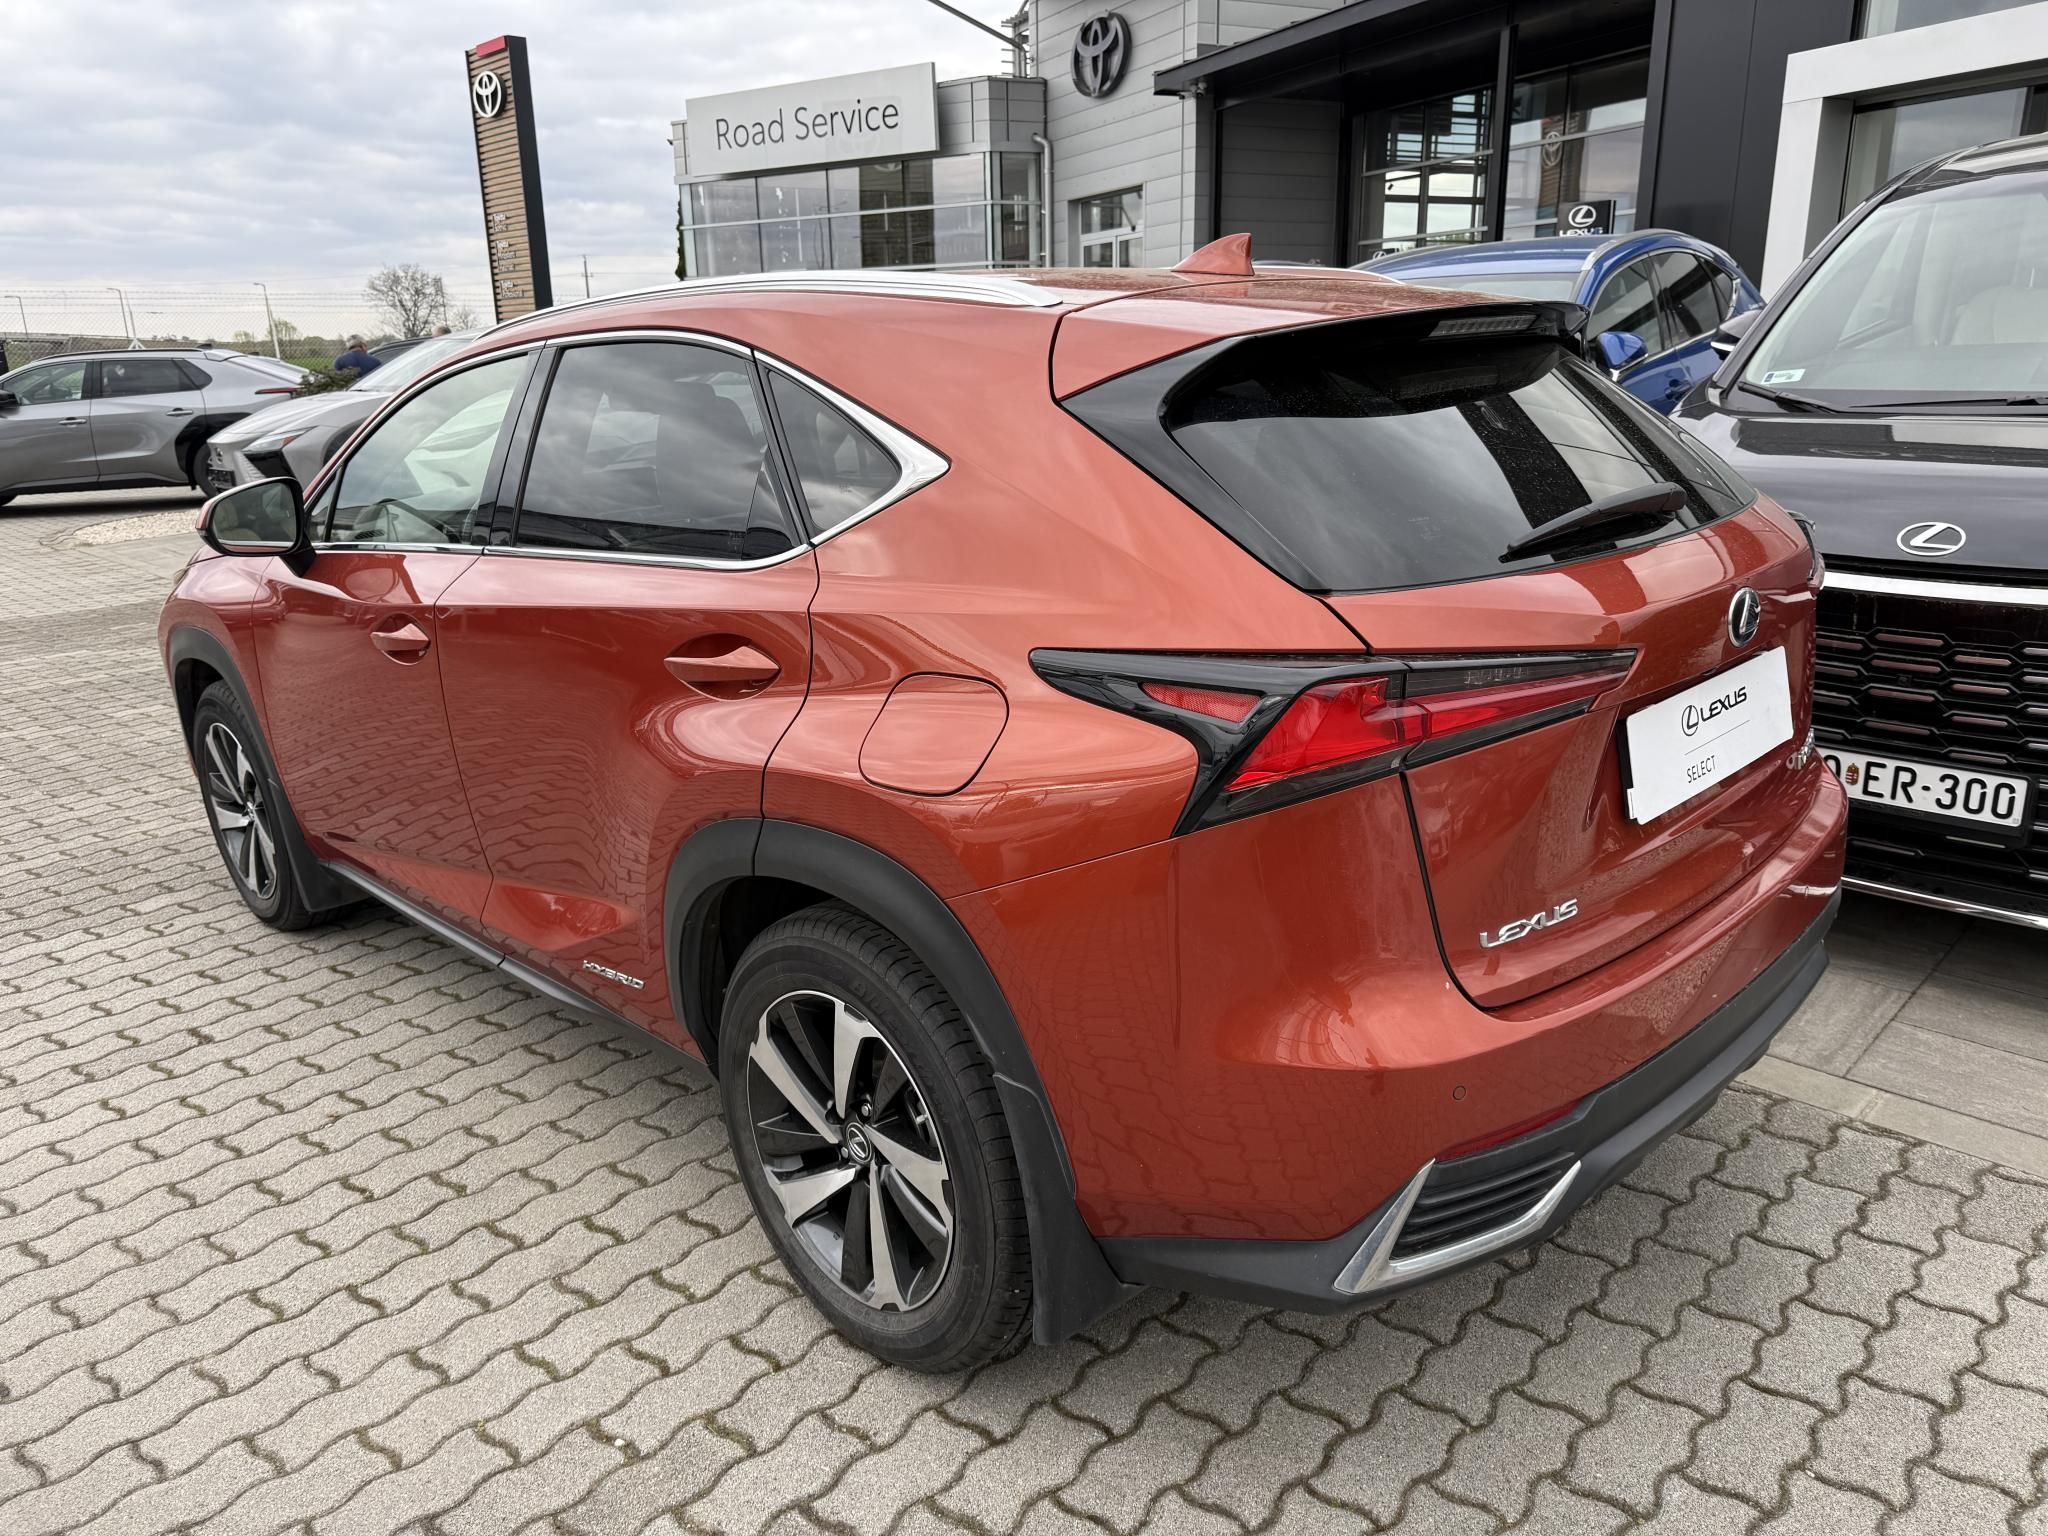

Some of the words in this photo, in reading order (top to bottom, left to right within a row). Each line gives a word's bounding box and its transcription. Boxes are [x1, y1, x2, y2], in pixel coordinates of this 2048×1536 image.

[715, 107, 785, 151] Road
[794, 98, 900, 141] Service
[1700, 686, 1748, 722] LEXUS
[1686, 754, 1716, 784] SELECT
[1479, 898, 1579, 949] LEXUS
[582, 960, 645, 991] HYBRID
